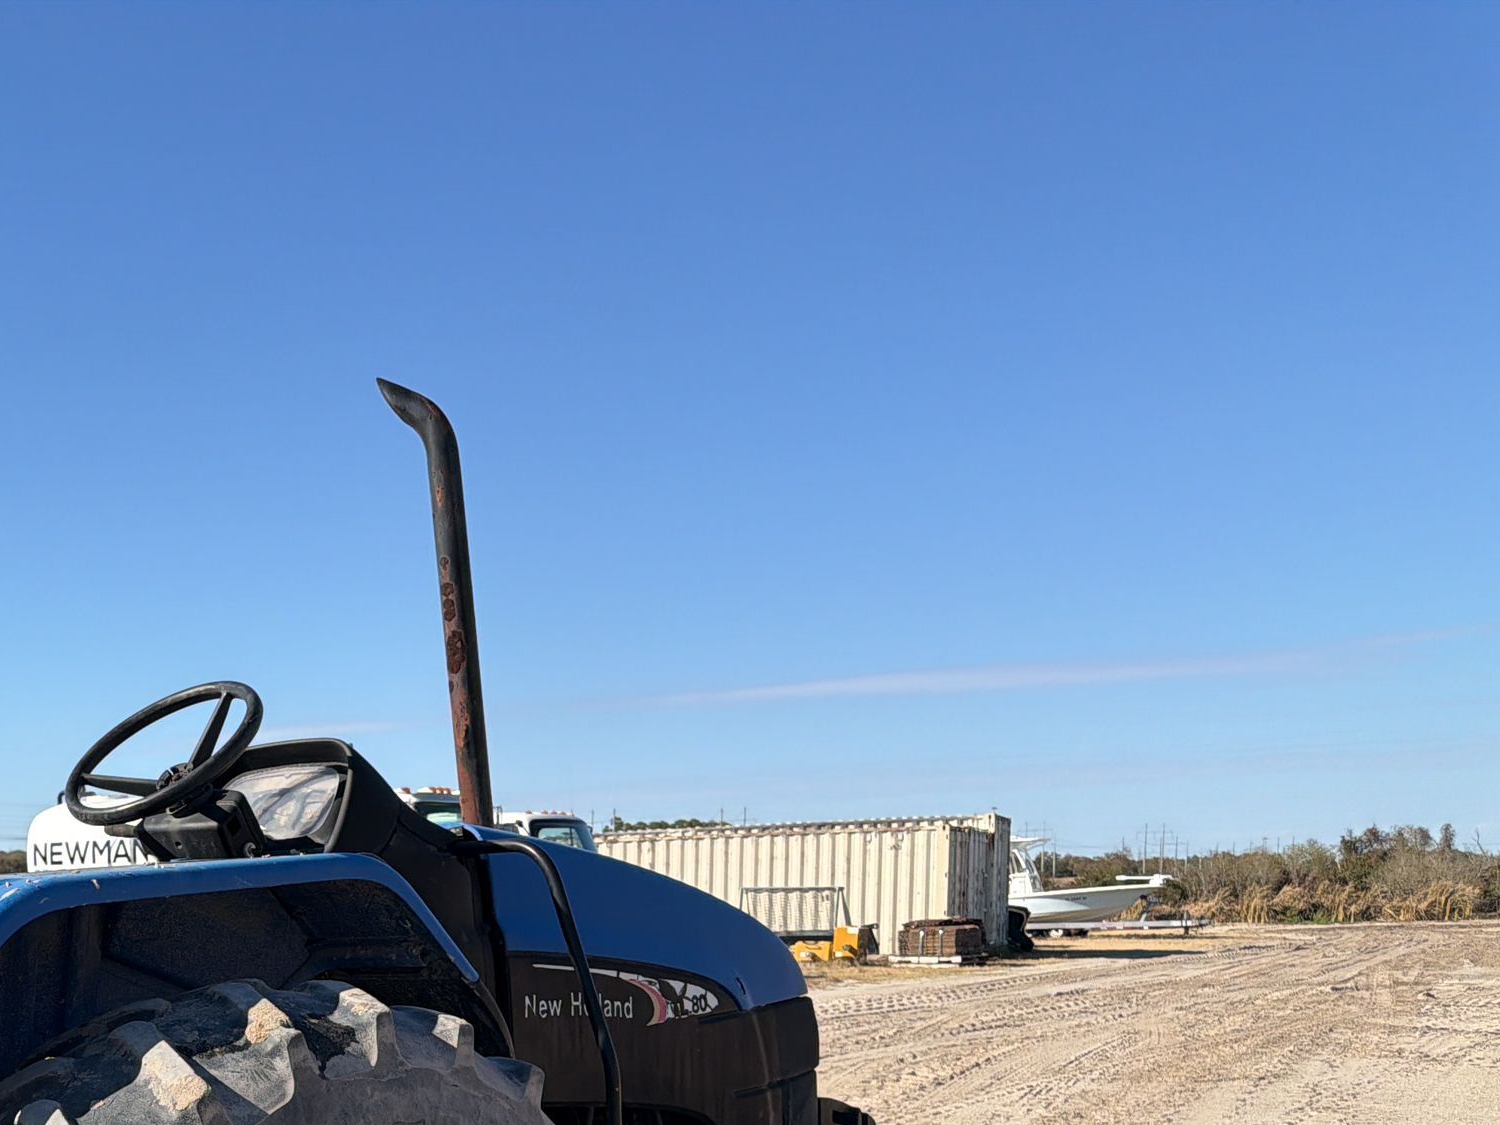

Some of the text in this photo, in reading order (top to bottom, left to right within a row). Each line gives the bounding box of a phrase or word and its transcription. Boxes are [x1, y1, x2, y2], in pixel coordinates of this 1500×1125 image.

[33, 839, 149, 866] NEWMAN
[524, 992, 633, 1018] New Hland
